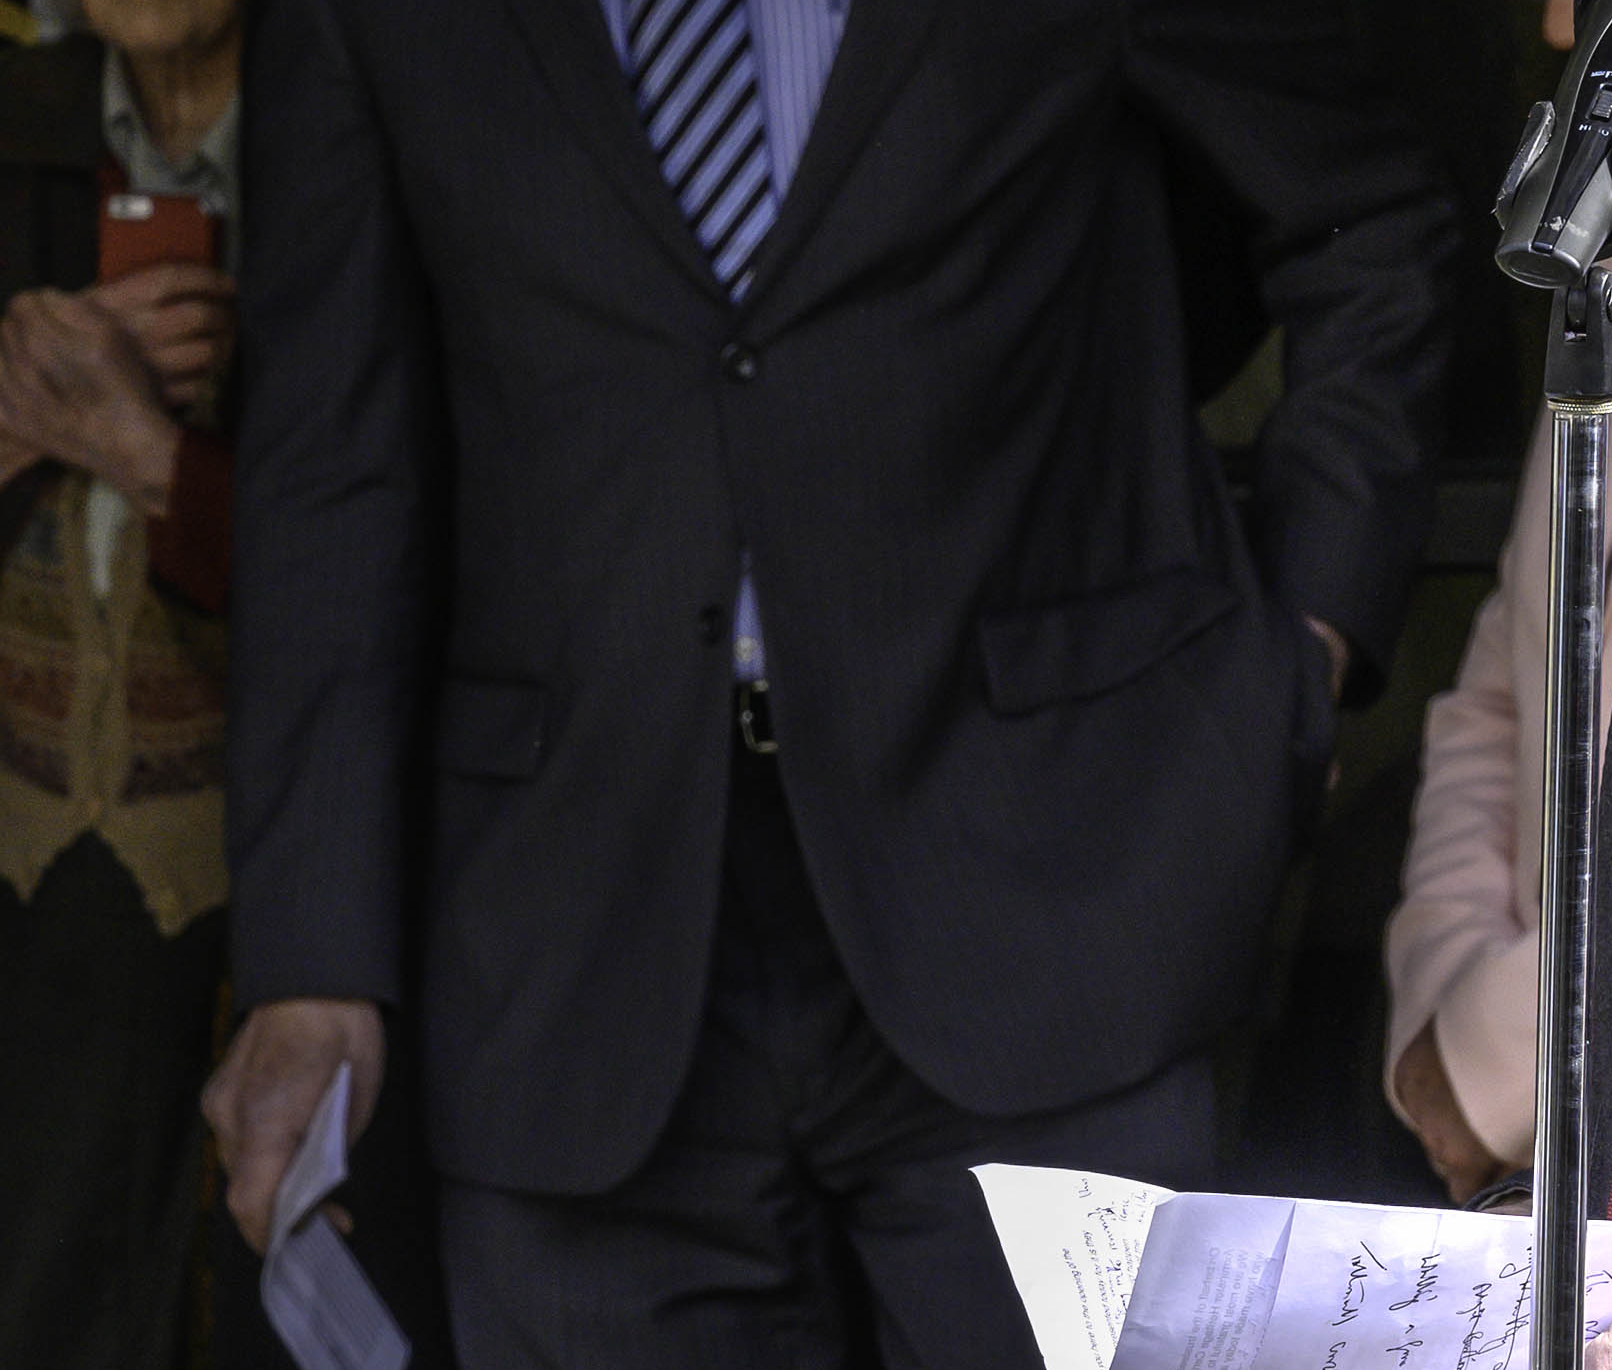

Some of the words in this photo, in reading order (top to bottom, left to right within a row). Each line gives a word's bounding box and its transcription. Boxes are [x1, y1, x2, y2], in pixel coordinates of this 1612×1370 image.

[1061, 1248, 1072, 1261] the
[1071, 1271, 1087, 1303] opening
[1081, 1305, 1090, 1319] the
[1085, 1321, 1092, 1330] to
